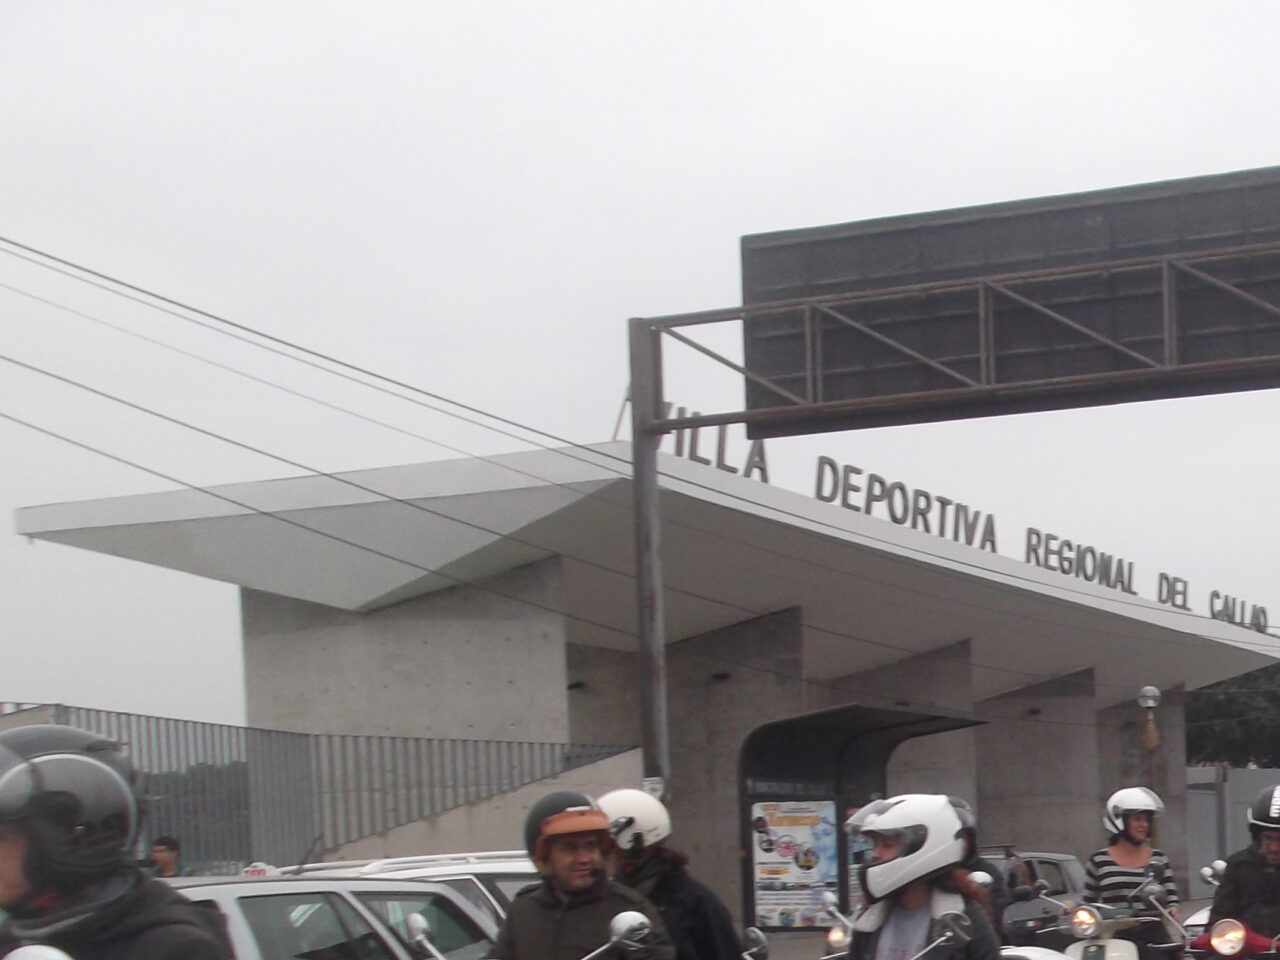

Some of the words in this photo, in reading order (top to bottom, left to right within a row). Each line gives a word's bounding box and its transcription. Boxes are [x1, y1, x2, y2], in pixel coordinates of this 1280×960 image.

[815, 455, 997, 553] DEPORTIVA
[1025, 527, 1137, 596] REGIONAL
[1159, 572, 1192, 611] DEL
[1210, 590, 1267, 633] CALLAO
